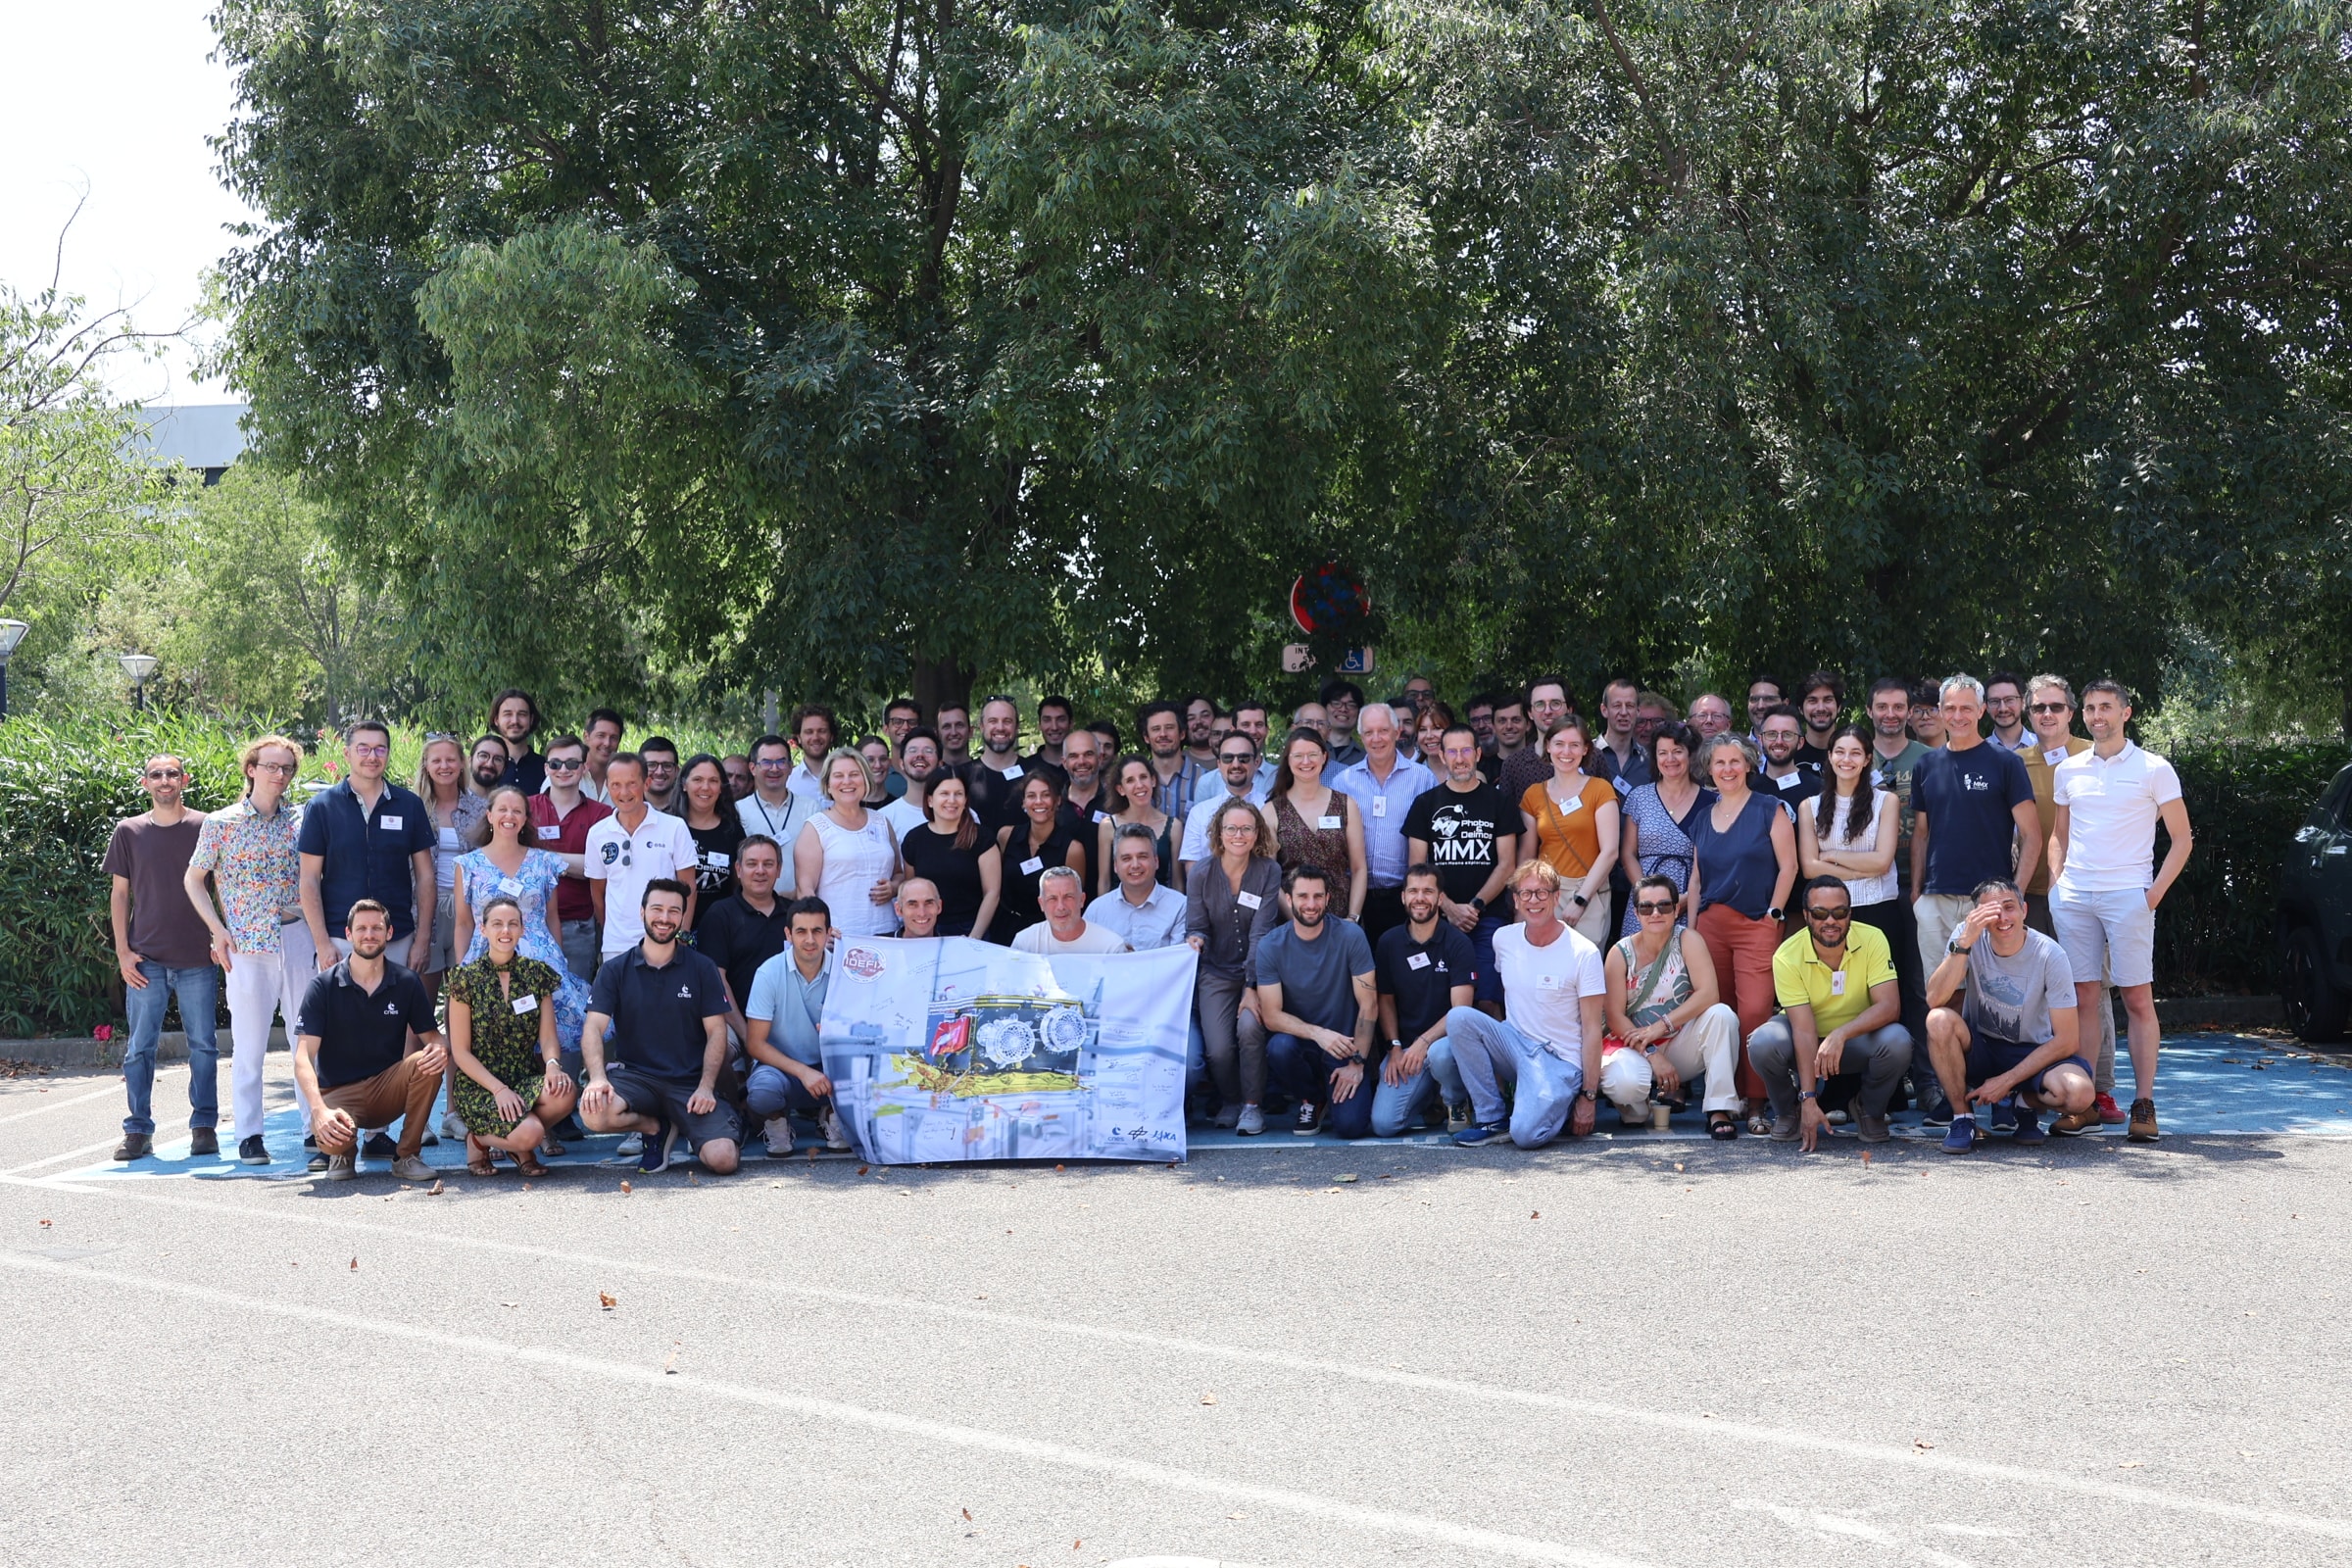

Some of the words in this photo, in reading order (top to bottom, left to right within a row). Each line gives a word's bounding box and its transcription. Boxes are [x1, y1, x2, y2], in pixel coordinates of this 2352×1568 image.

[1461, 819, 1494, 828] Phobos
[1433, 839, 1491, 861] MMX
[845, 957, 883, 968] IDEFIX
